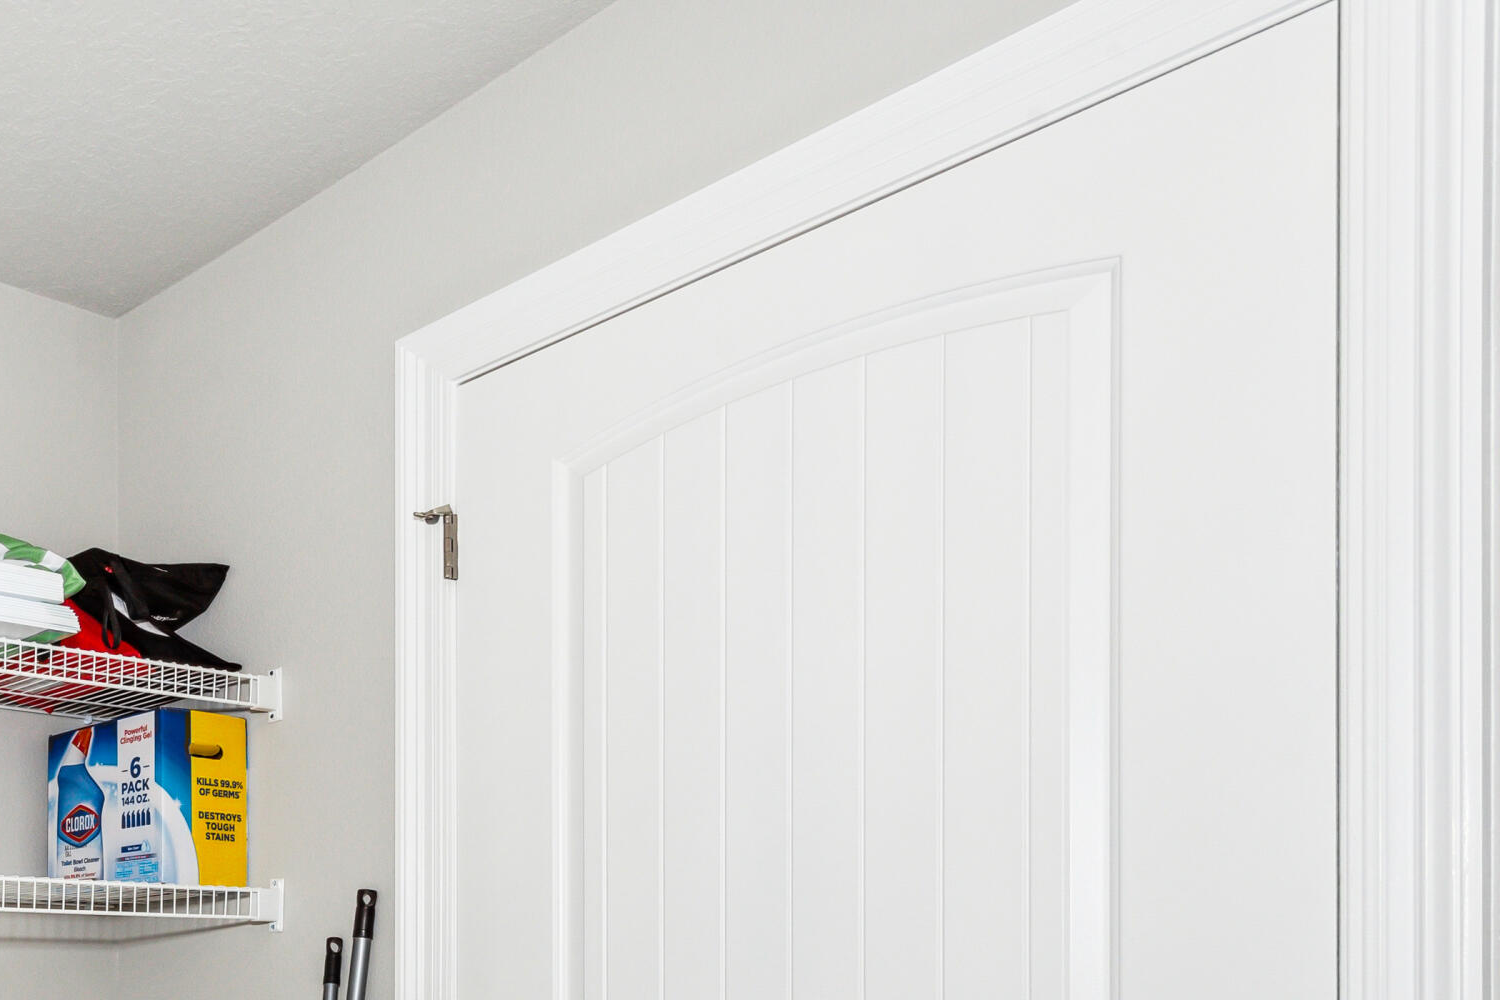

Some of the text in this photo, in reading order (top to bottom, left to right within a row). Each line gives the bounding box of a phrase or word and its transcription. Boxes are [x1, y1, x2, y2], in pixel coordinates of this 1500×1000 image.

[124, 725, 148, 736] Powerful
[120, 730, 152, 744] Clinging Gel
[130, 756, 141, 778] 6
[122, 778, 150, 794] PACK
[196, 777, 244, 790] KILLS 99.9%
[199, 788, 210, 796] OF
[122, 794, 150, 806] 144 OZ.
[198, 811, 242, 822] DESTROYS
[65, 814, 96, 833] CLOROX
[205, 822, 235, 832] TOUGH
[206, 832, 236, 842] STAINS
